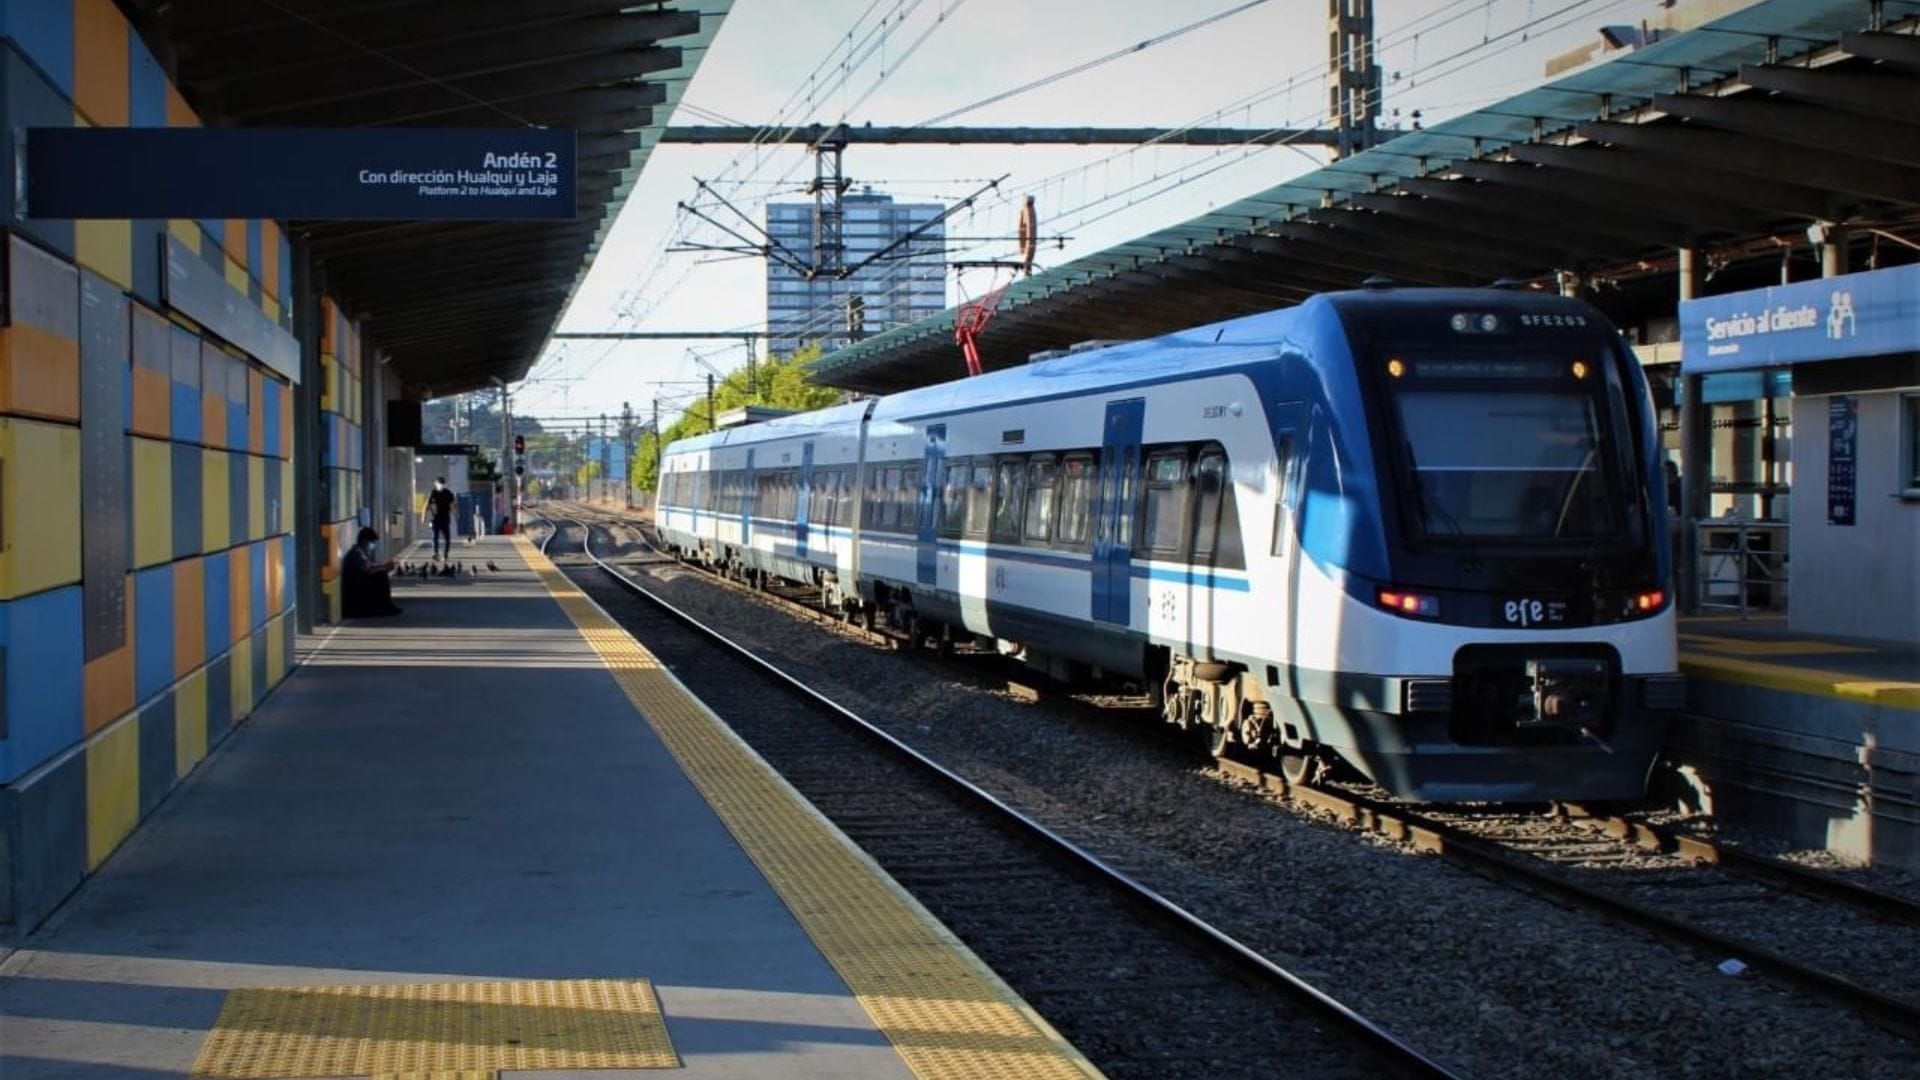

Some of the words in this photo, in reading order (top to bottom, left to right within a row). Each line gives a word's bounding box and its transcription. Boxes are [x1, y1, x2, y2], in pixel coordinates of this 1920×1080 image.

[484, 152, 541, 168] Andén
[545, 152, 557, 168] 2
[360, 170, 387, 183] Con
[390, 170, 454, 183] dirección
[458, 170, 513, 186] Hualqui
[516, 173, 525, 186] y
[529, 170, 557, 186] Laja
[419, 186, 459, 195] Platform
[461, 186, 468, 195] 2
[469, 186, 479, 195] to
[480, 186, 517, 197] Hualqui
[518, 187, 536, 195] and
[537, 187, 557, 197] Laja
[1707, 314, 1755, 341] Servicio
[1757, 310, 1770, 333] al
[1771, 305, 1817, 331] cliente
[1505, 599, 1543, 627] efe
